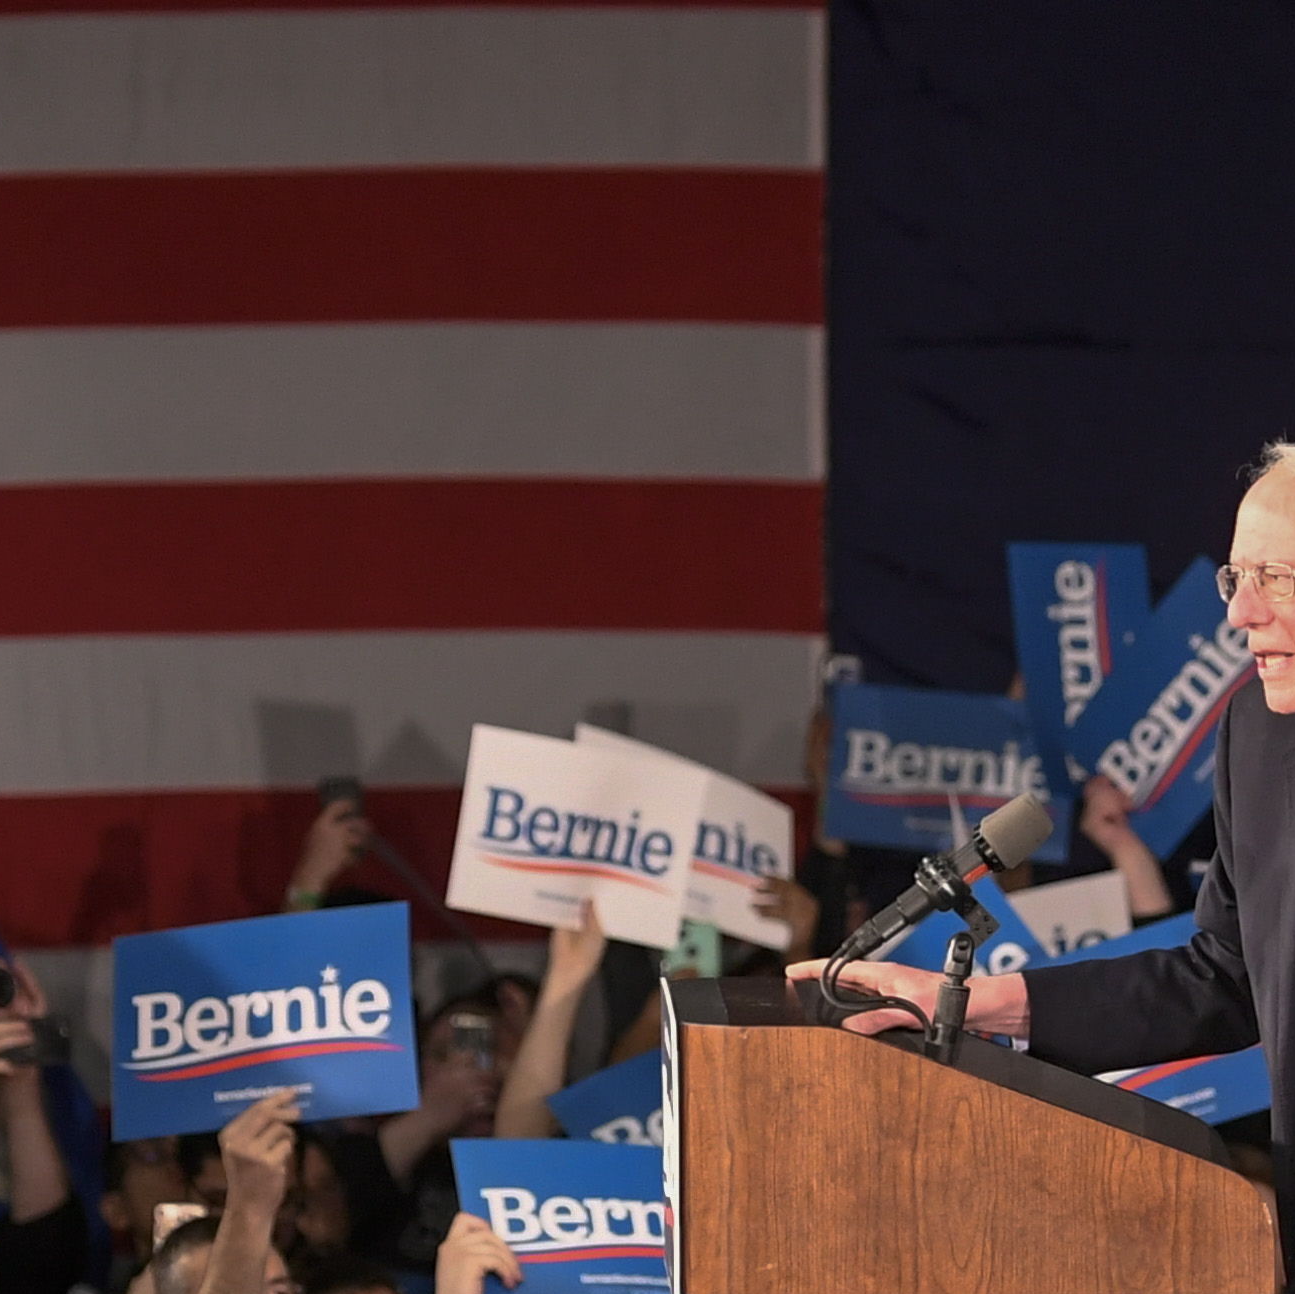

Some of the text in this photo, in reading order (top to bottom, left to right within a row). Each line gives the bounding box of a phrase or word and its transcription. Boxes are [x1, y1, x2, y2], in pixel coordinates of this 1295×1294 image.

[482, 785, 673, 876] Bernie
[130, 965, 393, 1062] Bernie
[480, 1187, 666, 1245] Bern
